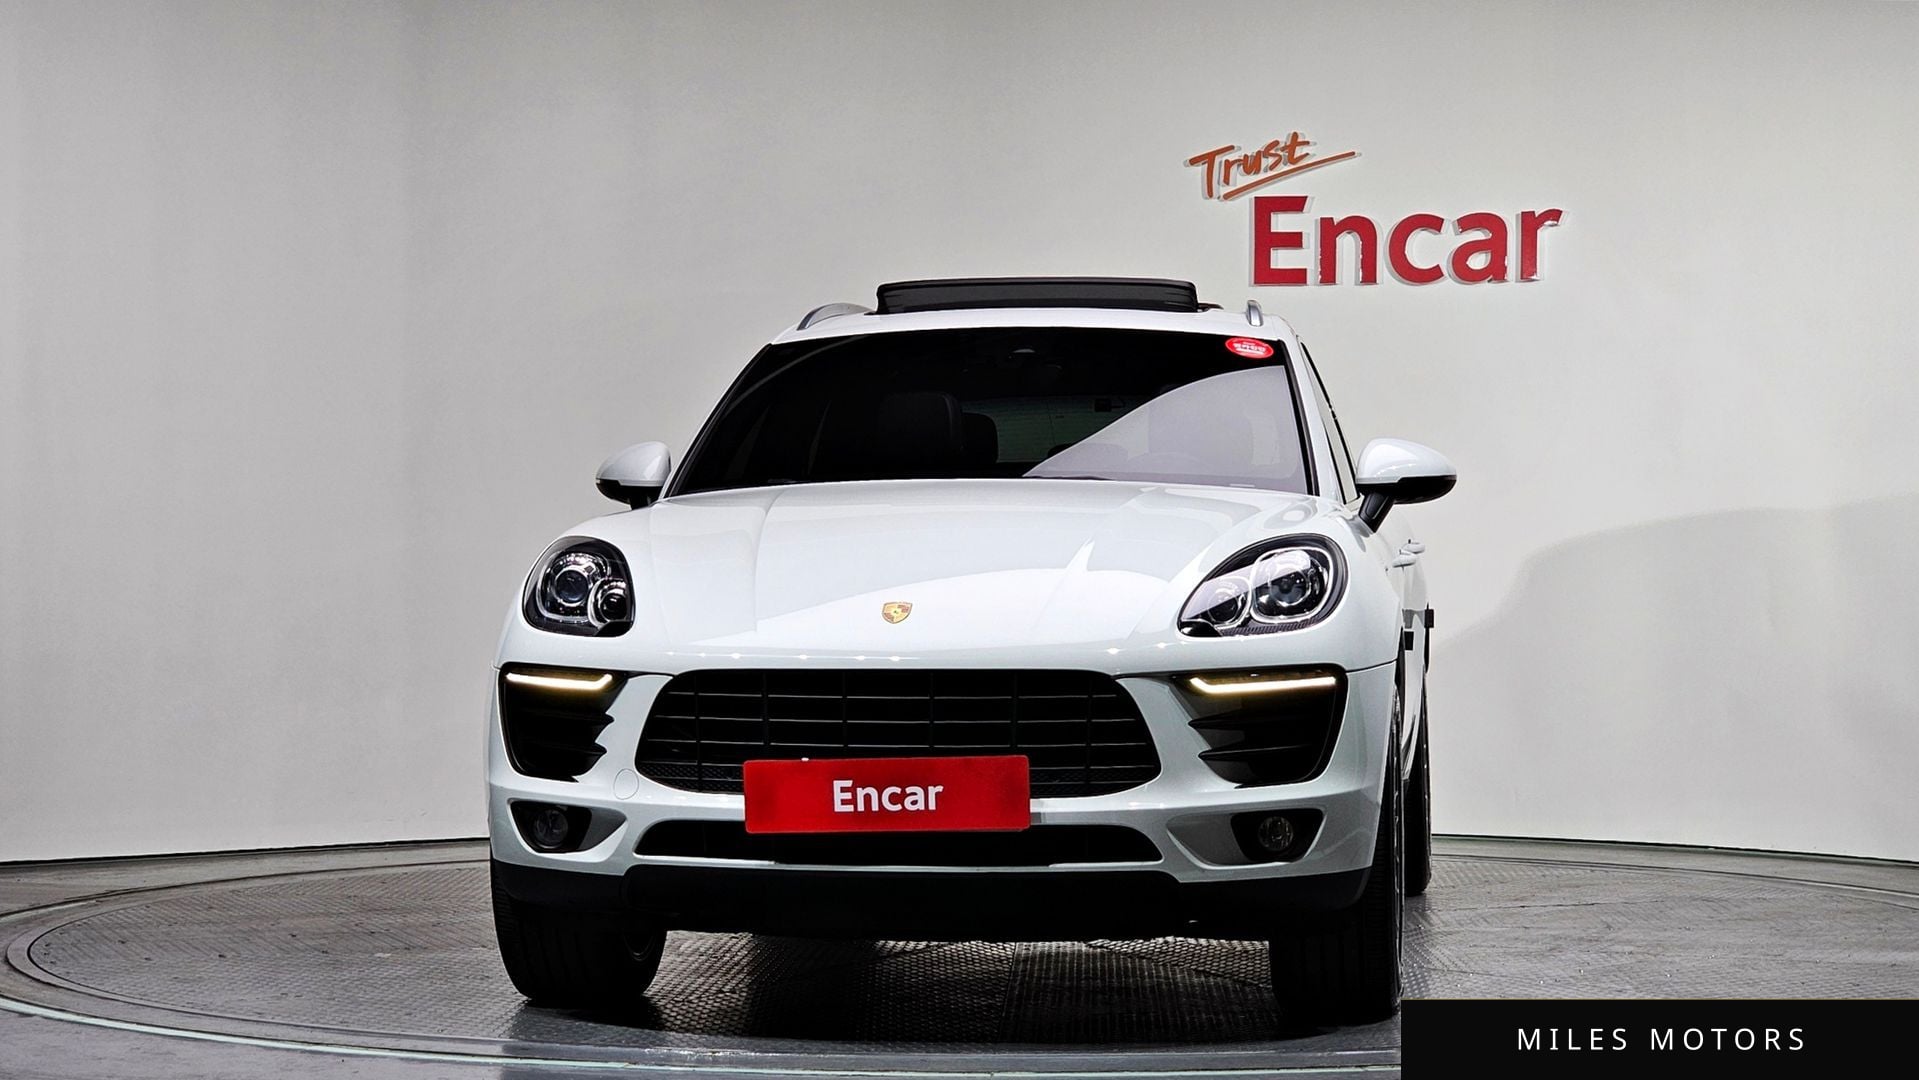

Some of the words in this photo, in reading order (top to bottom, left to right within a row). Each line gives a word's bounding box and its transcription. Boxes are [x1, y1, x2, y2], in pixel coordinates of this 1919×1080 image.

[1188, 131, 1312, 199] Trust
[1252, 195, 1563, 285] Encar
[832, 779, 944, 812] Encar
